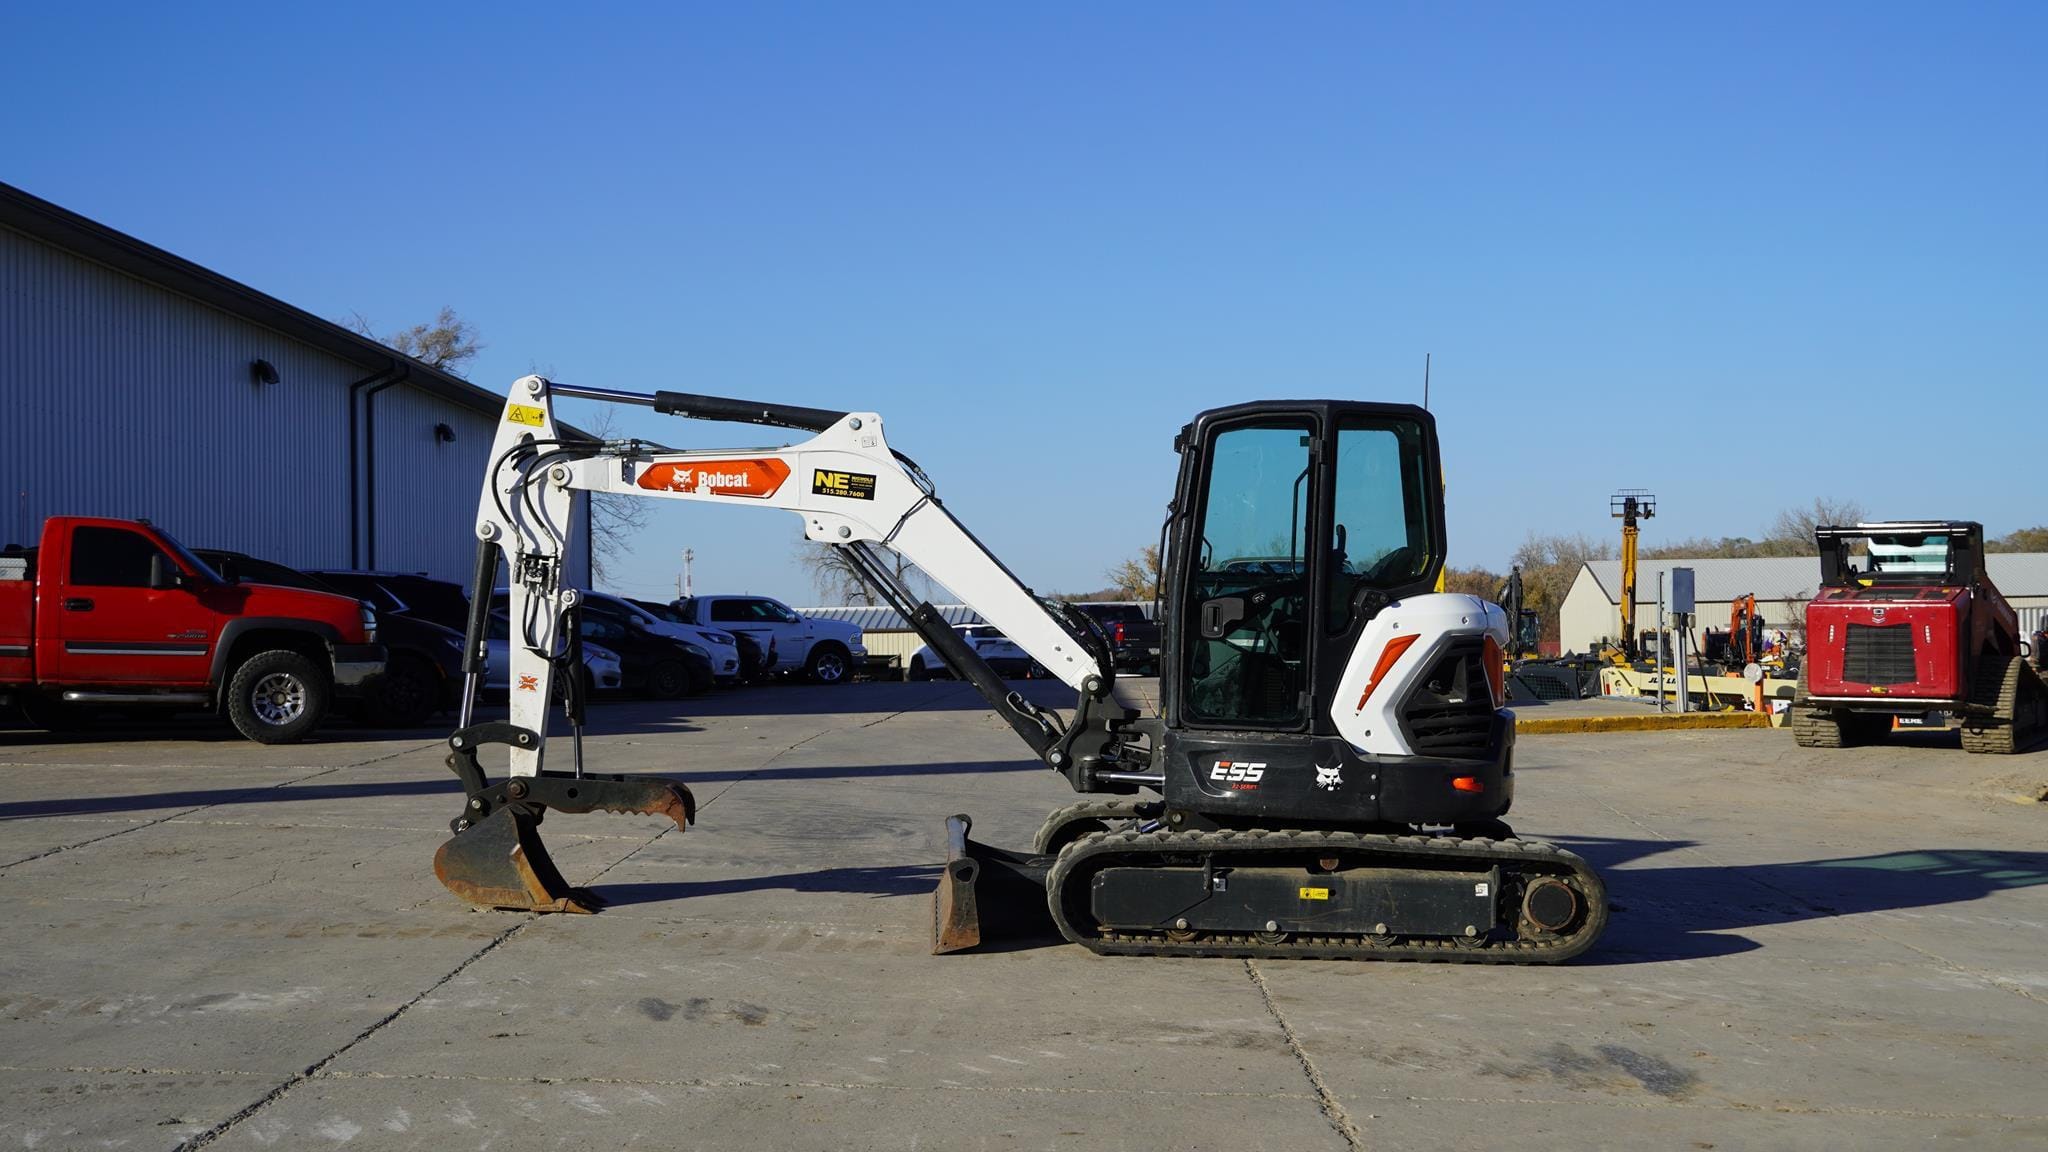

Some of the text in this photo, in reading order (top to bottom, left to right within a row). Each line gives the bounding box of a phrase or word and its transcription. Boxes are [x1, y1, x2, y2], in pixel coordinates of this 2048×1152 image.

[698, 471, 748, 488] Bobcat
[815, 471, 850, 490] NE
[822, 487, 865, 498] 515.280.7600
[1210, 761, 1267, 782] E55
